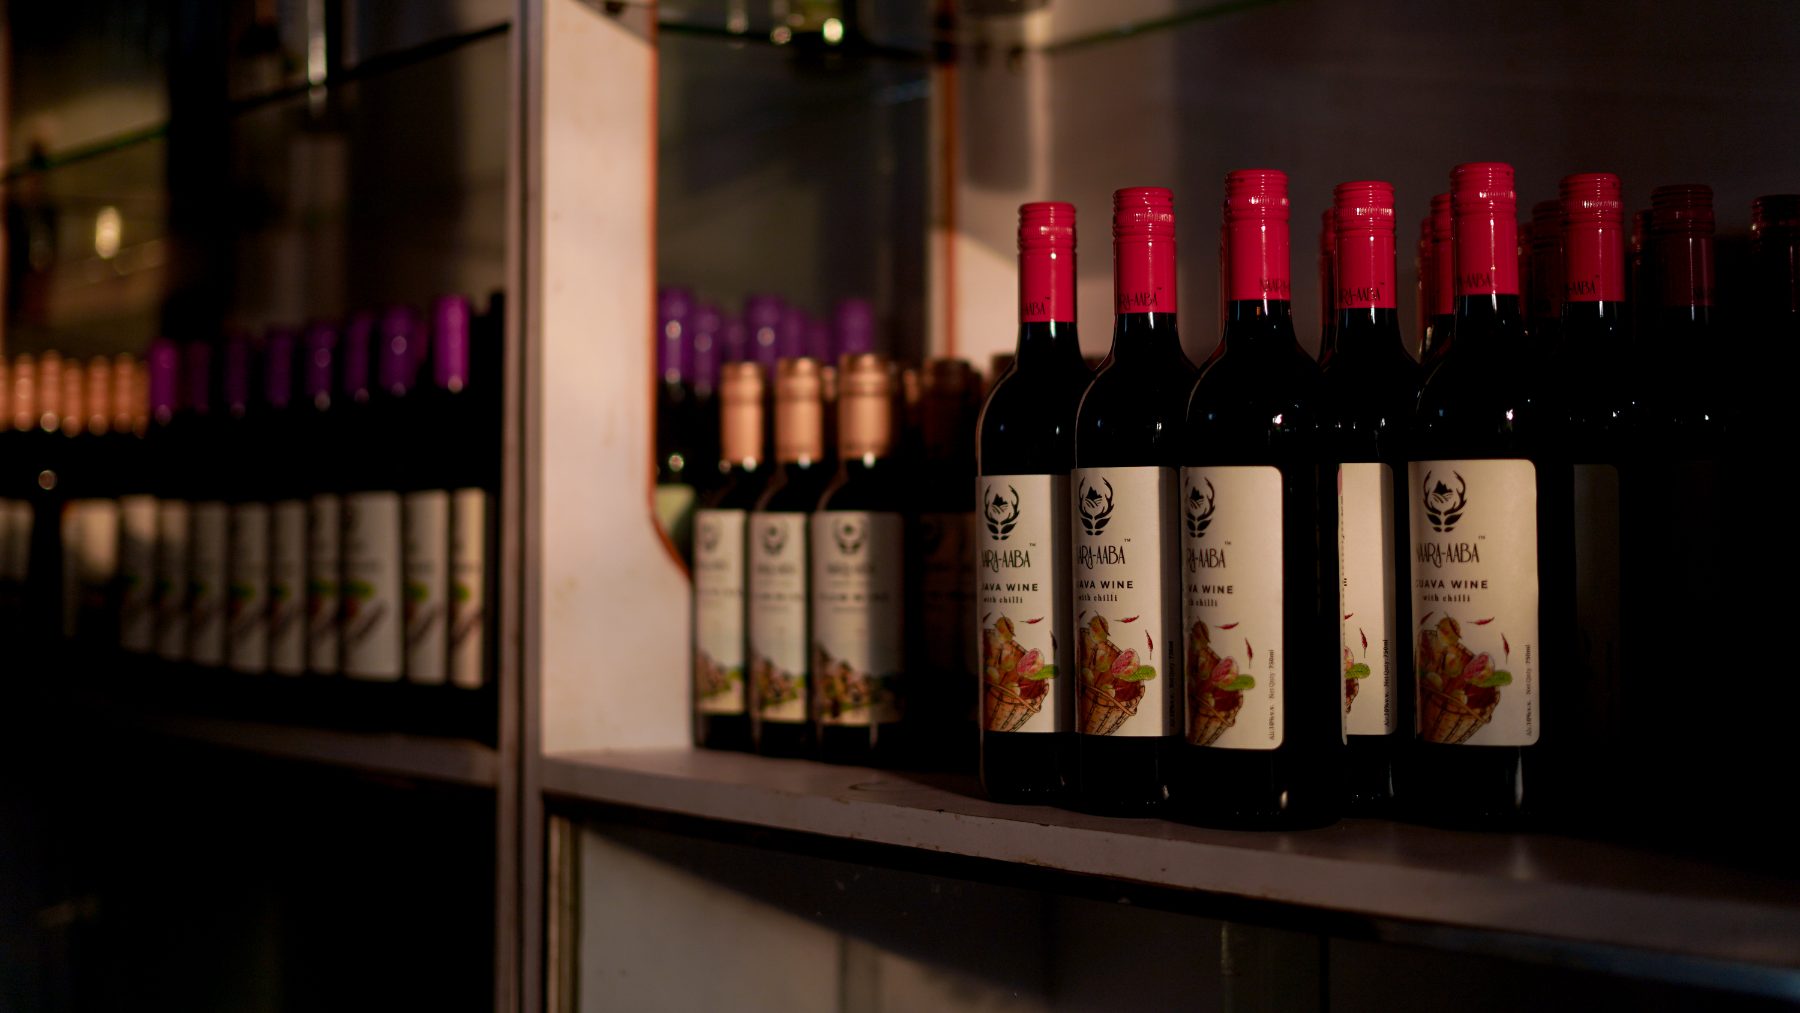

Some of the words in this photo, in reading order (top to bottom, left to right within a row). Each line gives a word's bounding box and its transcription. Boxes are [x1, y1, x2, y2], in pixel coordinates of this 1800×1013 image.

[1006, 583, 1039, 592] WINE
[1100, 580, 1134, 589] WINE
[1451, 580, 1488, 589] WINE
[1202, 585, 1234, 594] WINE
[999, 596, 1023, 604] chilli
[1093, 593, 1118, 602] chilli
[1443, 593, 1470, 602] chilli
